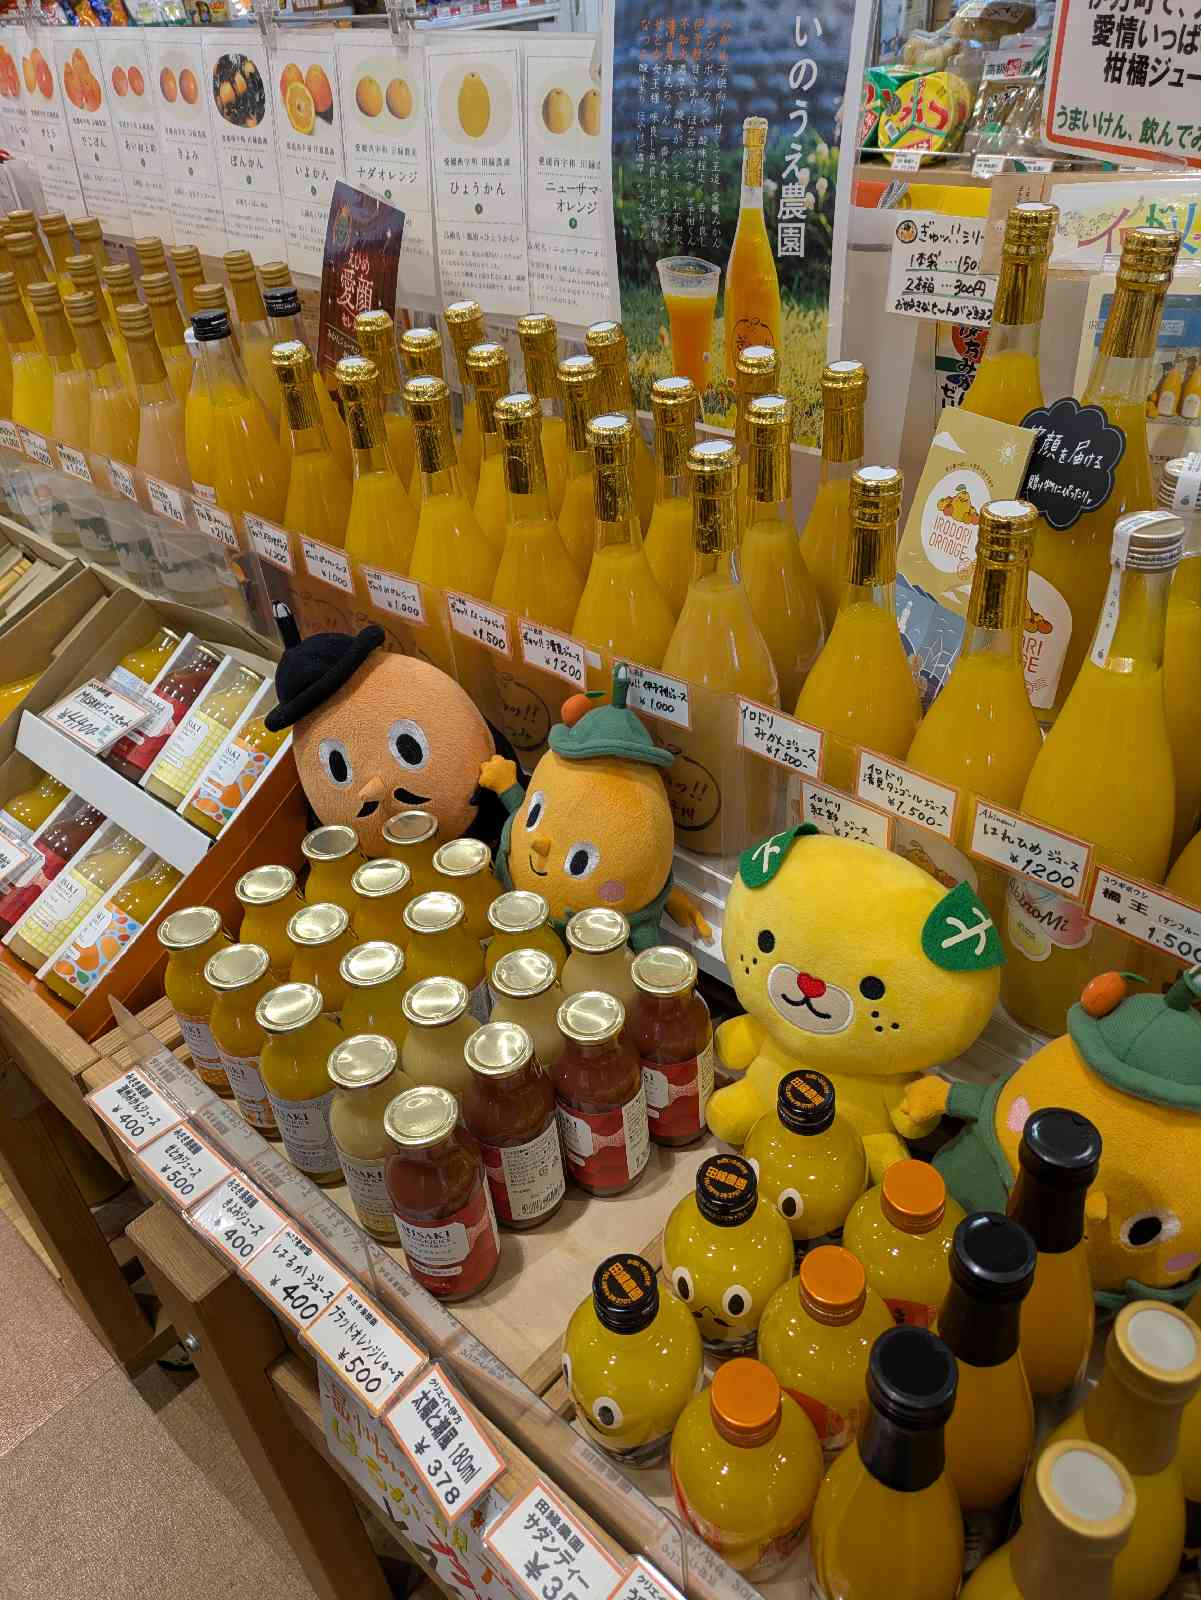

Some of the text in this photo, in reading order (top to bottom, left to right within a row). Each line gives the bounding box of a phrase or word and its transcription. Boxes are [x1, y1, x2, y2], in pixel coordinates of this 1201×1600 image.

[777, 15, 824, 259] いのうえ農園
[450, 181, 506, 196] ひょうかん
[556, 199, 598, 215] オレンジ
[931, 517, 974, 543] IRODORI
[740, 706, 774, 729] イロドリ
[867, 763, 904, 786] イロドリ
[449, 1441, 484, 1487] 180ml
[523, 1513, 590, 1591] サダンディー
